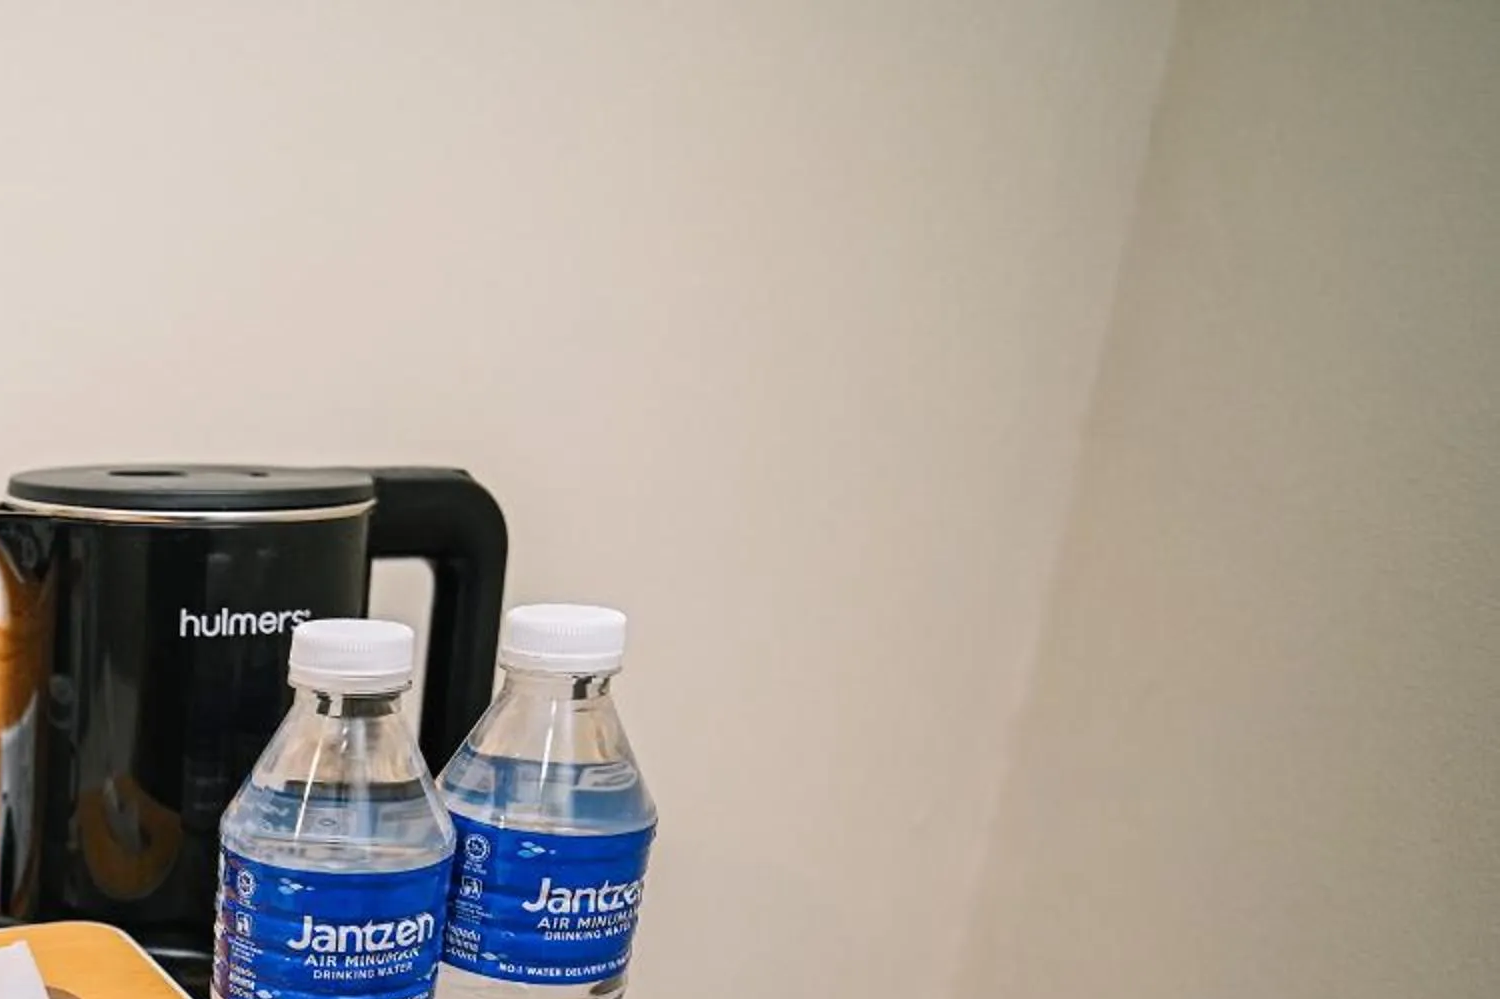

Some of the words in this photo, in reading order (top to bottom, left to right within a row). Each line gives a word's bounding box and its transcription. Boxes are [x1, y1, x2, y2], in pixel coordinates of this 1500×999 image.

[522, 877, 643, 914] Jantze
[537, 916, 570, 929] AIR
[286, 912, 434, 952] Jantzen
[545, 930, 601, 941] DRINKING
[304, 954, 337, 967] AIR
[313, 968, 375, 980] DRINKING
[377, 962, 413, 977] WATER
[525, 966, 562, 976] WATER
